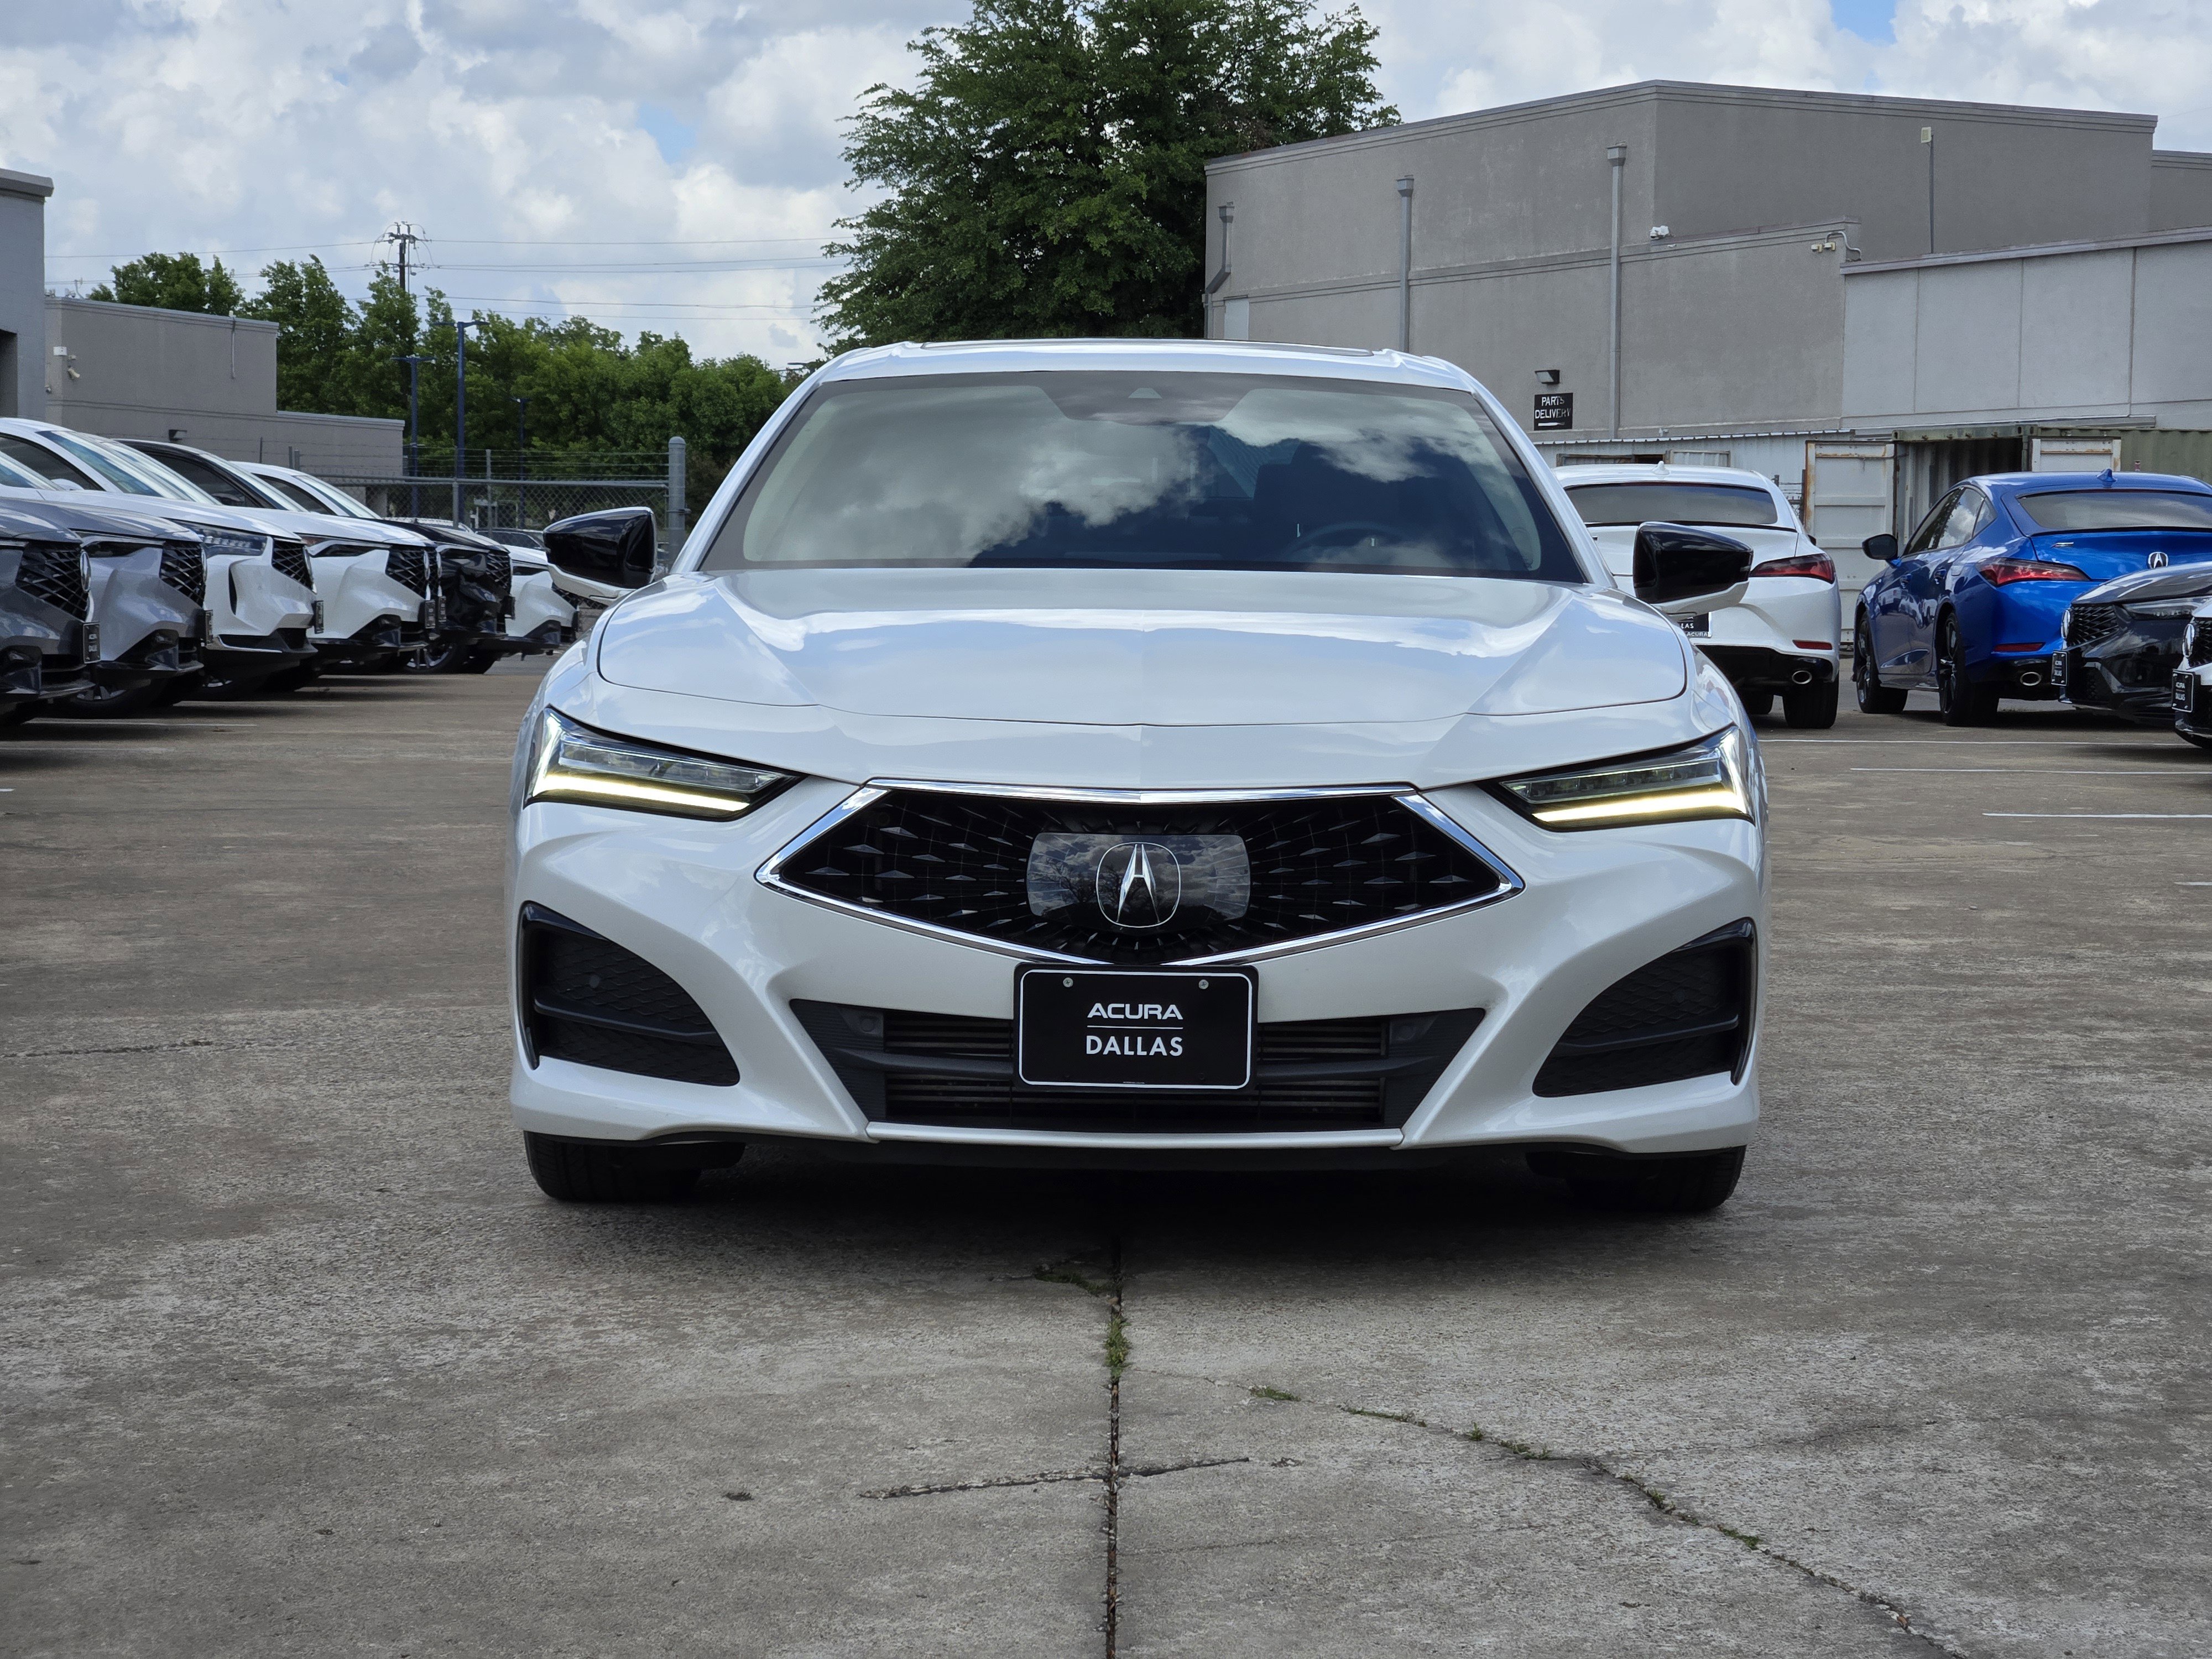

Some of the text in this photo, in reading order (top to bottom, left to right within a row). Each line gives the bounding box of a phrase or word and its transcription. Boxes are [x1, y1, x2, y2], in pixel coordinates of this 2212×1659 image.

[1541, 396, 1565, 406] PARTS
[1535, 408, 1571, 419] DELIVERY
[1087, 1003, 1183, 1020] ACURA
[1086, 1035, 1183, 1056] DALLAS
